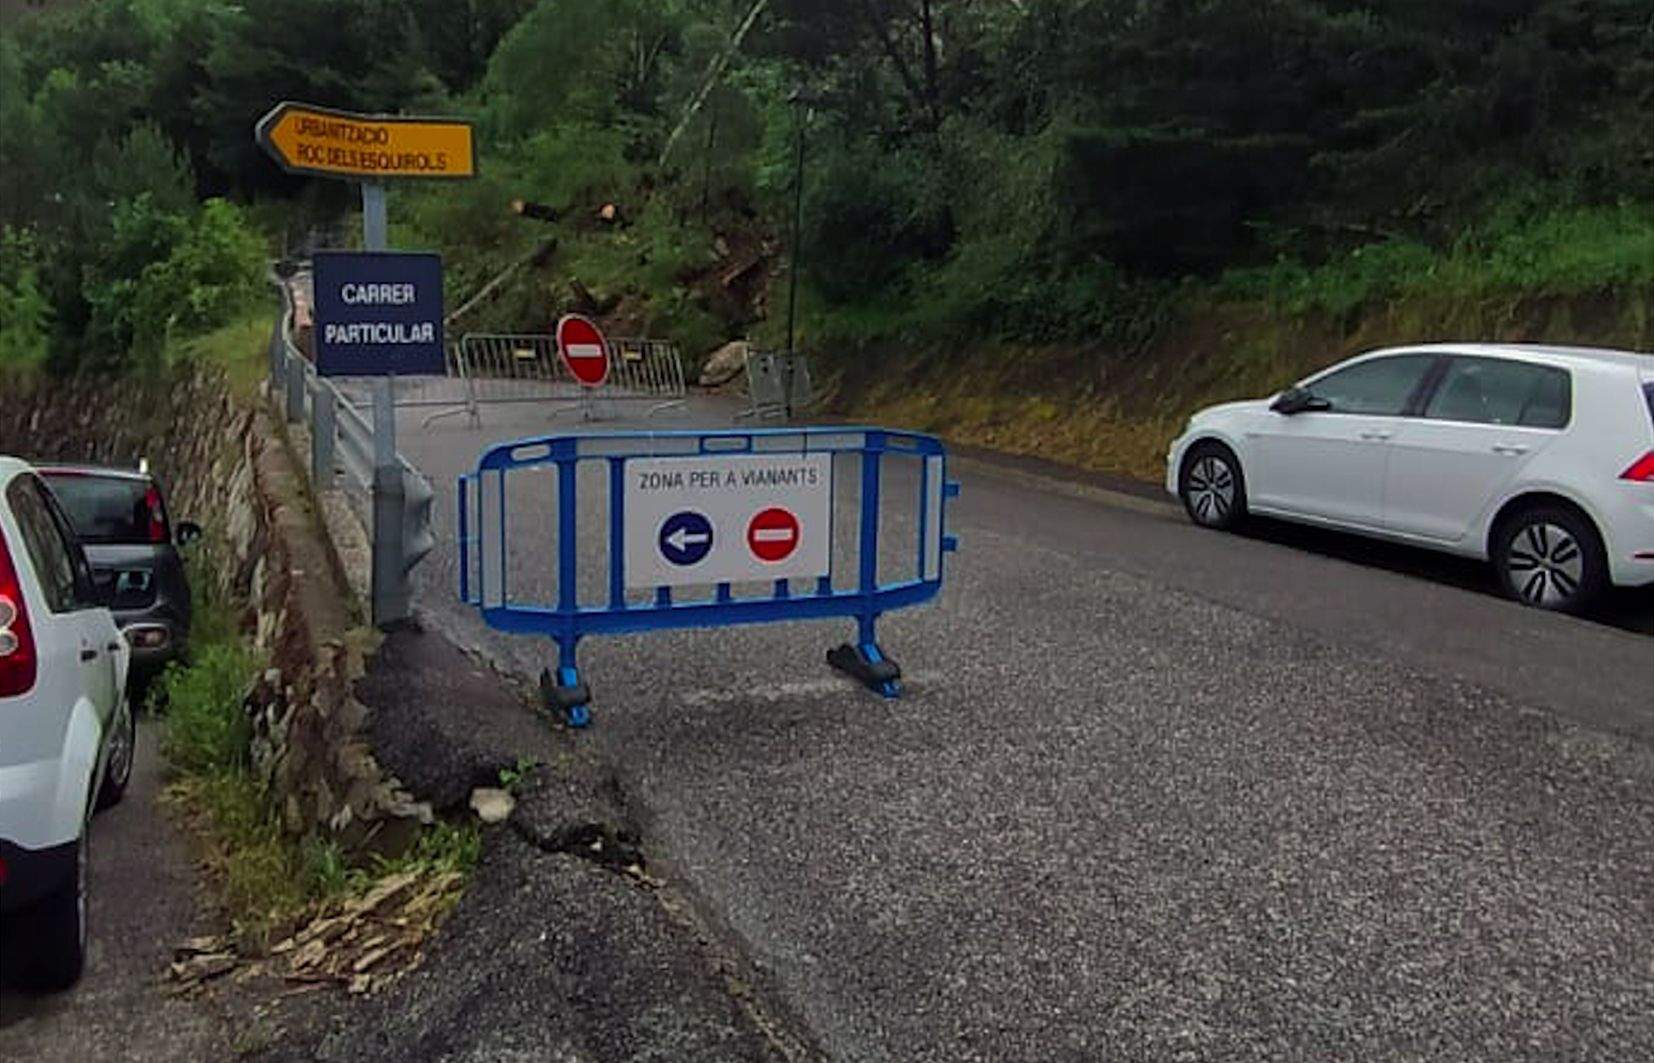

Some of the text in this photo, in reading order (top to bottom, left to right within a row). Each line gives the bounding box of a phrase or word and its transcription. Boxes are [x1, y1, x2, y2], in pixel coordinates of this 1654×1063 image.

[296, 144, 446, 171] ROC DELS ESQUIROLS
[341, 283, 416, 304] CARRER
[324, 322, 435, 343] PARTICULAR
[640, 468, 818, 490] ZONA PER A VIANANTS
